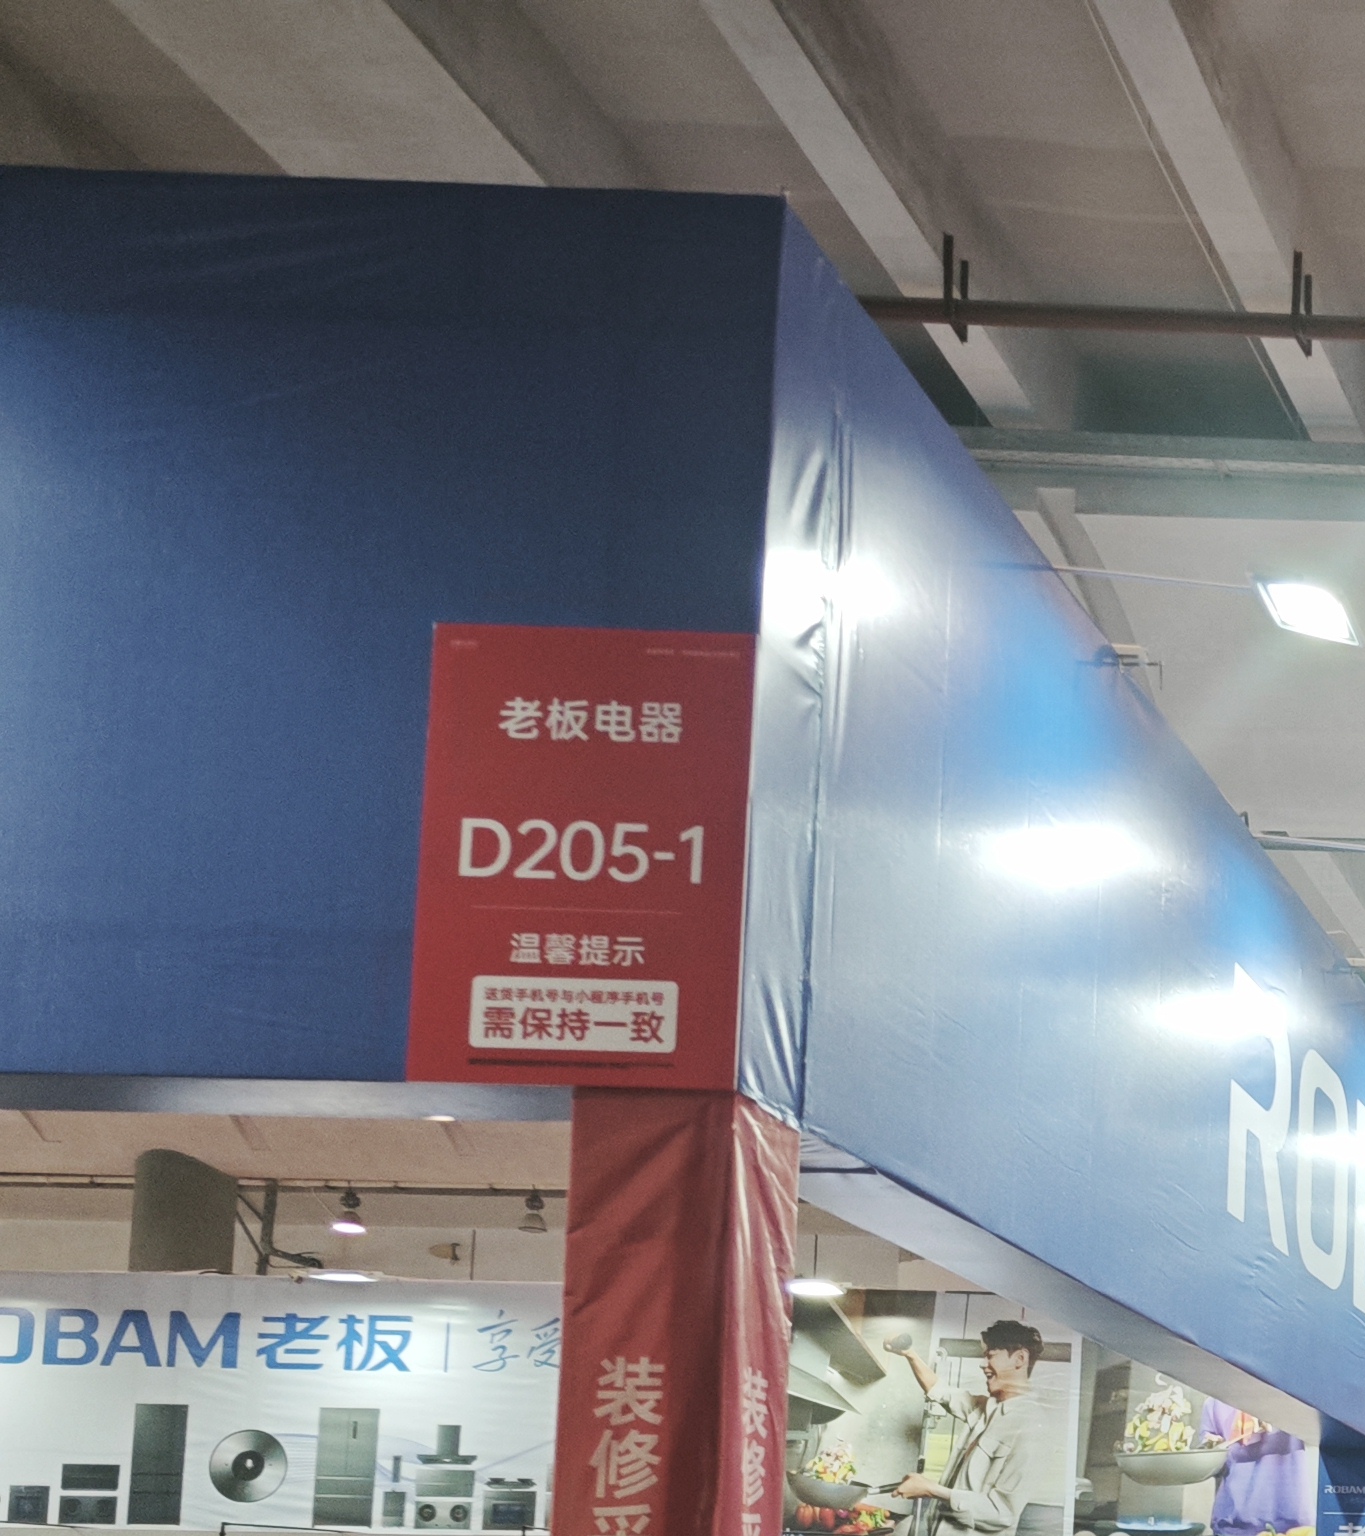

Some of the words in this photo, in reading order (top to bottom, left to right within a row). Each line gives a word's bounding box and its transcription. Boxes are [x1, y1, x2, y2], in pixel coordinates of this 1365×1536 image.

[499, 697, 682, 743] 老板电器
[458, 817, 705, 884] D205-1
[510, 933, 645, 966] 温馨提示
[482, 1007, 665, 1044] 需保持一致
[256, 1315, 414, 1372] 老板
[1324, 1484, 1365, 1495] ROBAM
